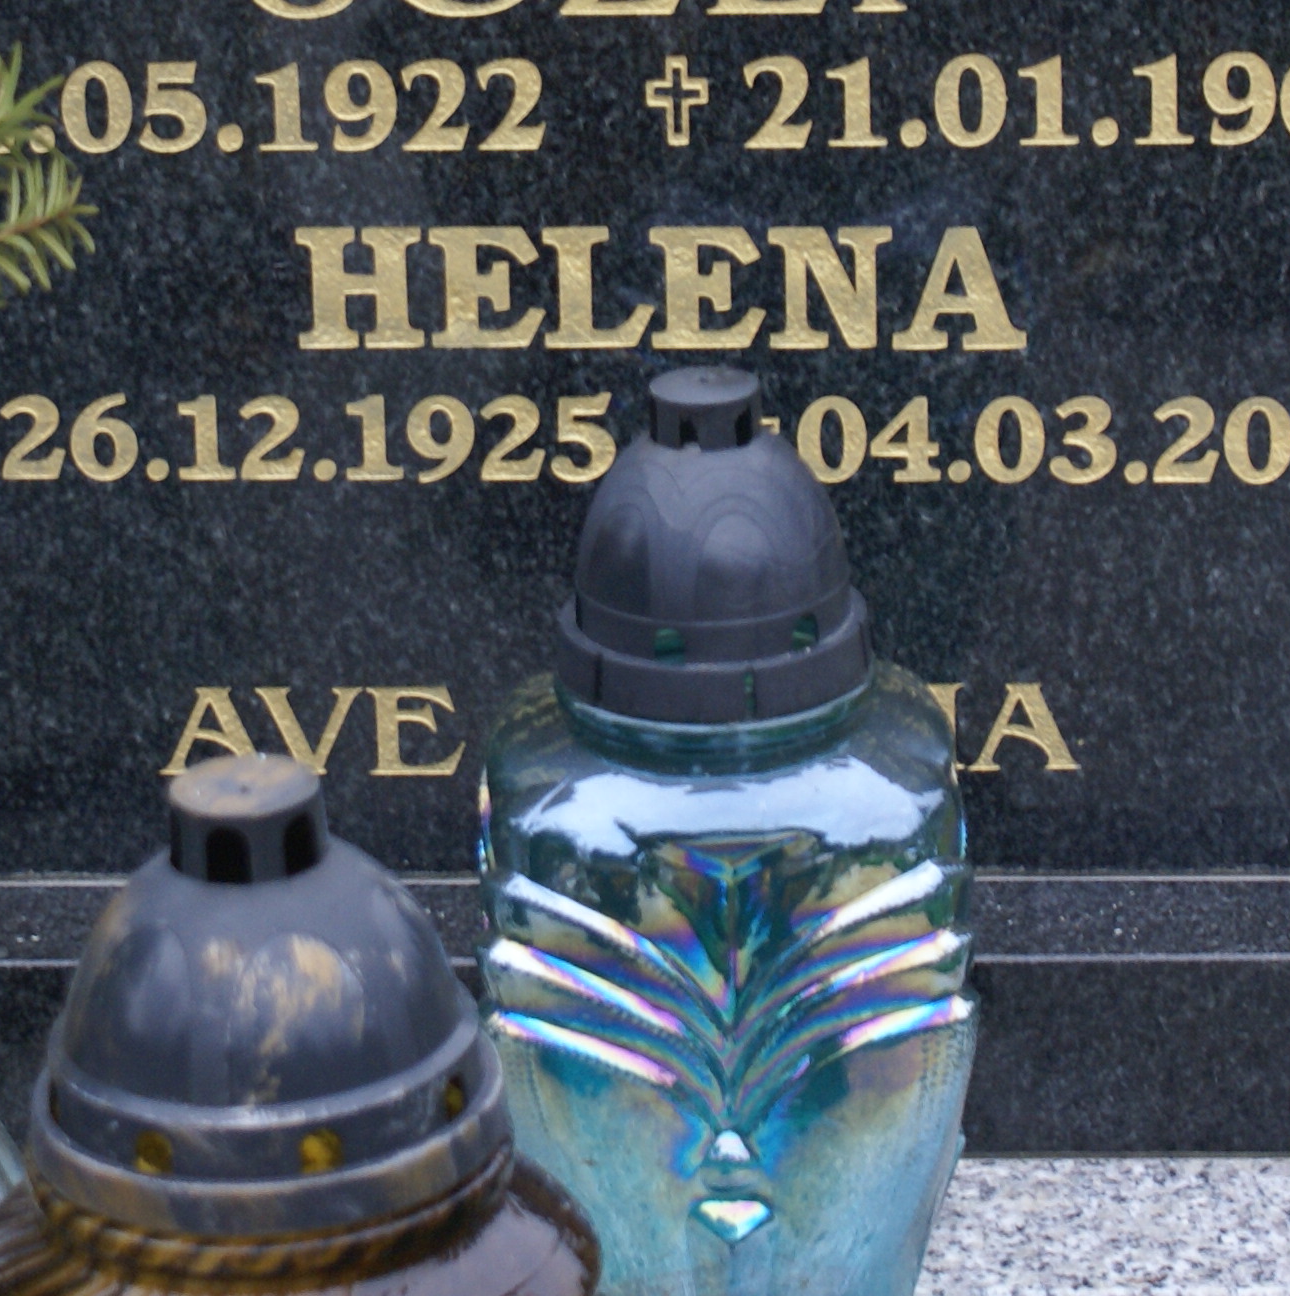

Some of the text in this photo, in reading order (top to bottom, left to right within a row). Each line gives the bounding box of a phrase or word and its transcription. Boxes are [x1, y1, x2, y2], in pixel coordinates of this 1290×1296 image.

[295, 225, 1029, 352] HELENA
[0, 391, 618, 484] 26.12.1925
[159, 685, 466, 778] AVE
